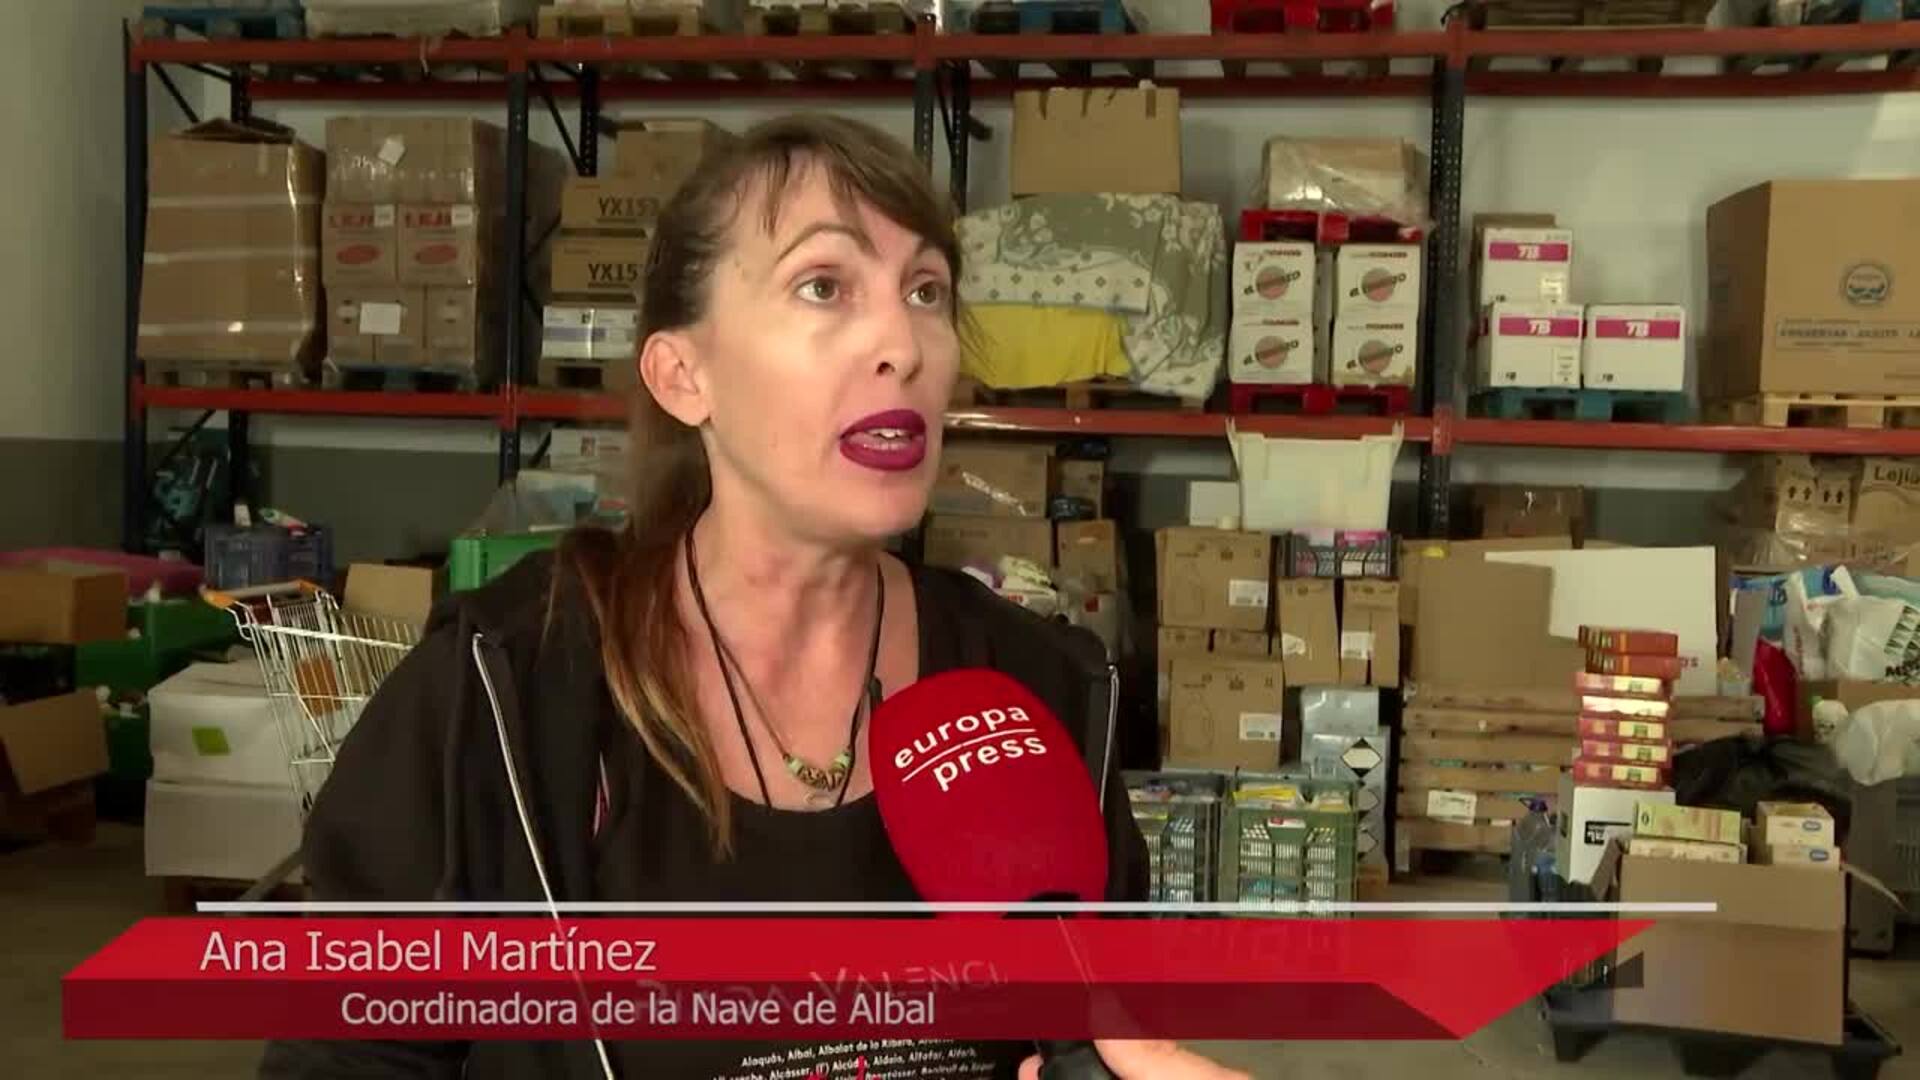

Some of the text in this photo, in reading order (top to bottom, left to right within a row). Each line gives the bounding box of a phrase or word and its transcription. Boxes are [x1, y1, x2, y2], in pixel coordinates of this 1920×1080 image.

[588, 262, 638, 281] YX15
[895, 706, 1030, 768] europa
[933, 736, 1047, 792] press
